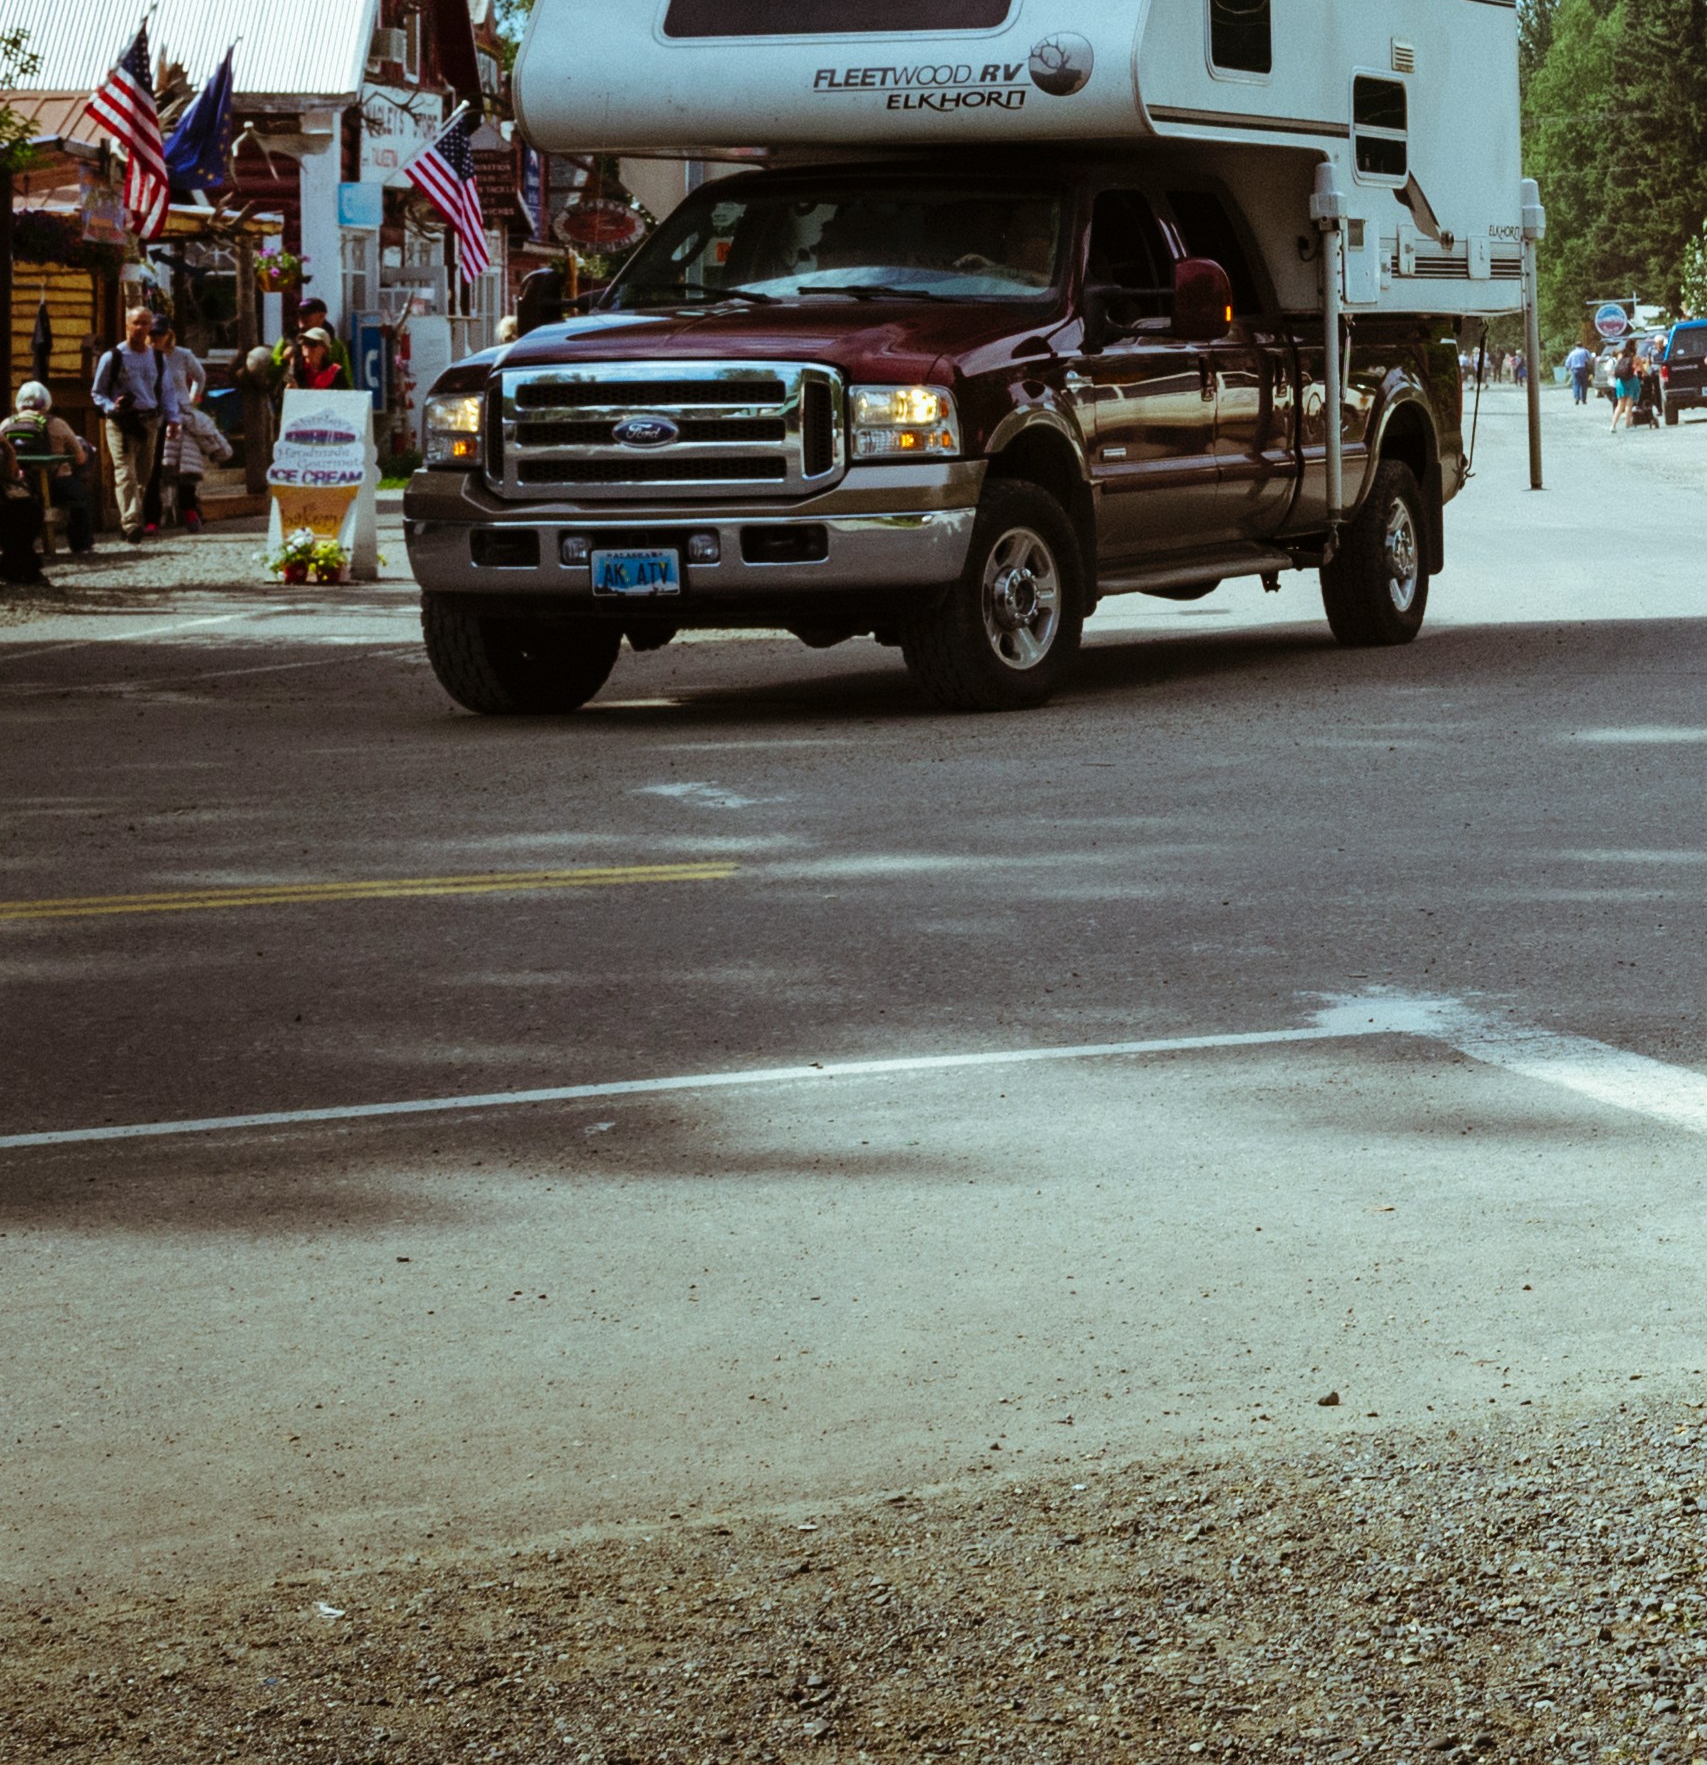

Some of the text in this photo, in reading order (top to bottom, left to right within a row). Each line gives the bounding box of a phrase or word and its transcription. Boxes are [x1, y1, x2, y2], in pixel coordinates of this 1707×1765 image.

[813, 63, 1024, 88] FLEETWOOD RV
[886, 91, 1026, 112] ELKHORN
[1489, 225, 1520, 241] ELKHORN
[626, 423, 660, 439] Ford
[270, 468, 363, 485] ICE CREAM
[603, 562, 668, 586] AK ATV
